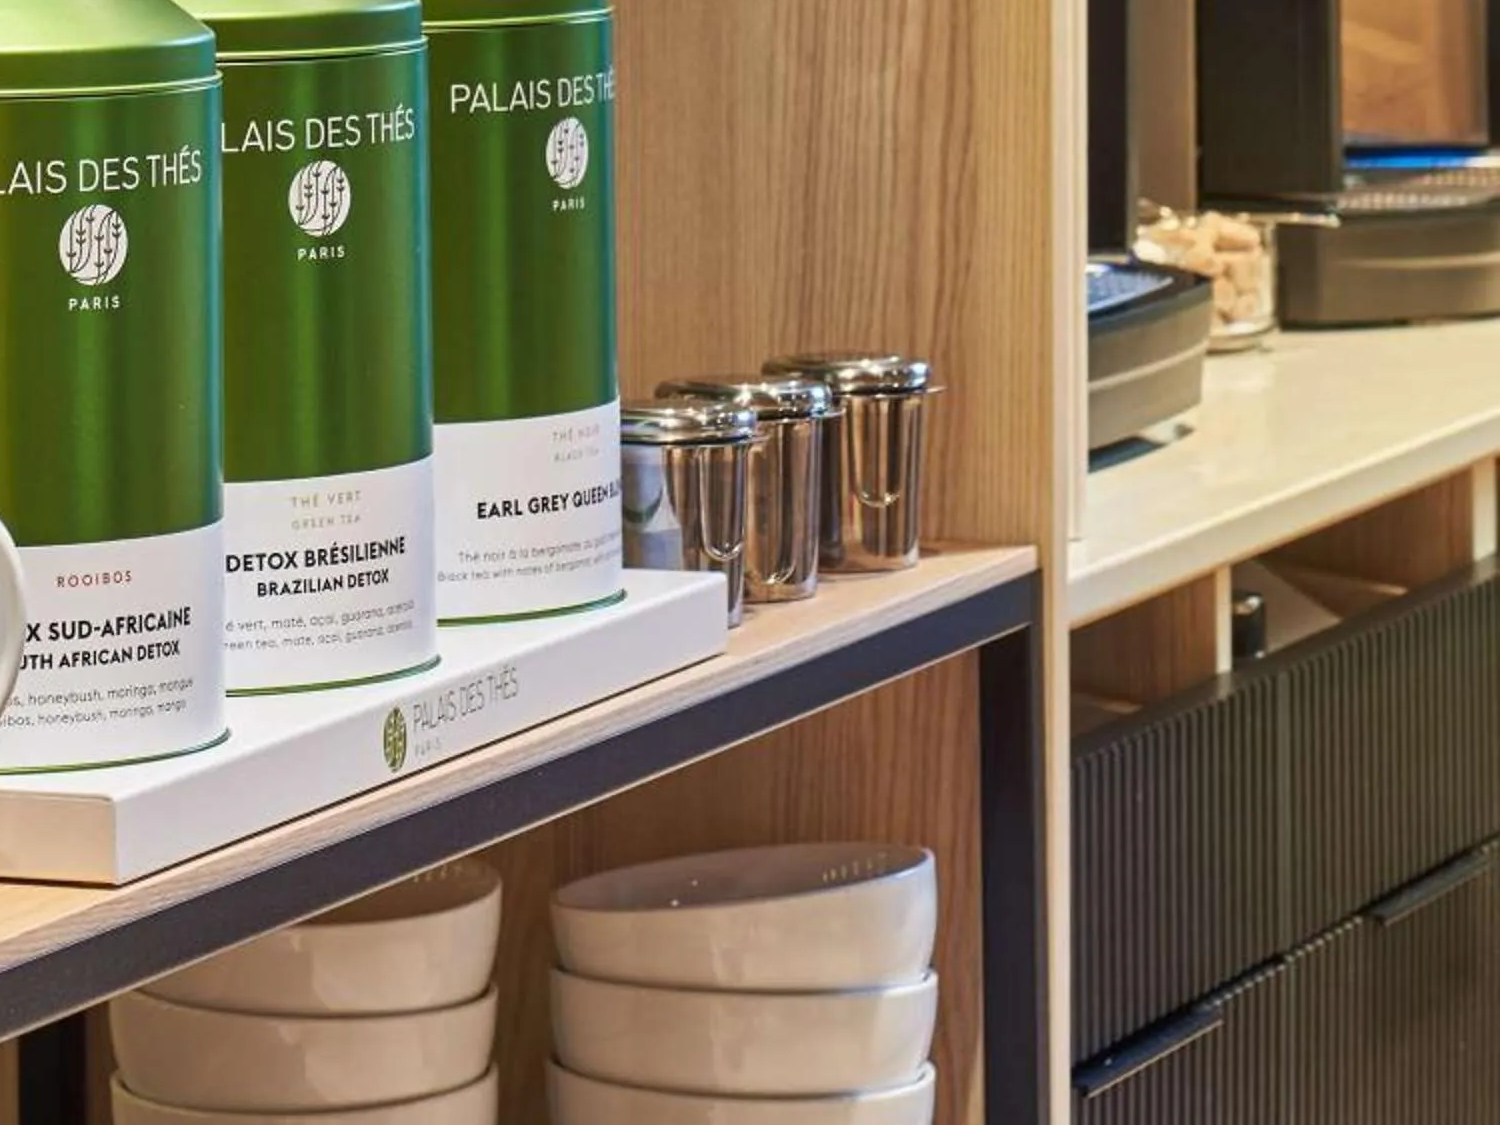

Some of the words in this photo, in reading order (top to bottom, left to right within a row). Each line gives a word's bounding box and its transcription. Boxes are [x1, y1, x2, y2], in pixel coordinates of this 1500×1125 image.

[451, 79, 551, 114] PALAIS
[557, 74, 595, 108] DES
[595, 65, 615, 102] THÉ
[220, 119, 296, 153] LAIS
[304, 114, 362, 150] DES
[365, 103, 415, 144] THÉS
[79, 156, 141, 193] DES
[146, 145, 202, 188] THÉS
[552, 196, 586, 212] PARIS
[297, 246, 346, 261] PARIS
[68, 295, 121, 312] PARIS
[476, 498, 523, 520] EARL
[527, 492, 569, 515] GREY
[572, 485, 608, 508] QUEEN
[225, 550, 299, 573] DETOX
[304, 536, 406, 568] BRÉSILIENNE
[56, 570, 133, 588] ROOIBOS
[257, 576, 344, 598] BRAZILIAN
[348, 569, 390, 590] DETOX
[48, 606, 192, 643] SUD-AFRICAINE
[20, 653, 53, 671] UTH
[58, 646, 133, 669] AFRICAN
[136, 639, 181, 662] DETOX
[224, 639, 254, 650] reen
[413, 689, 457, 733] PALAIS
[459, 679, 486, 717] DES
